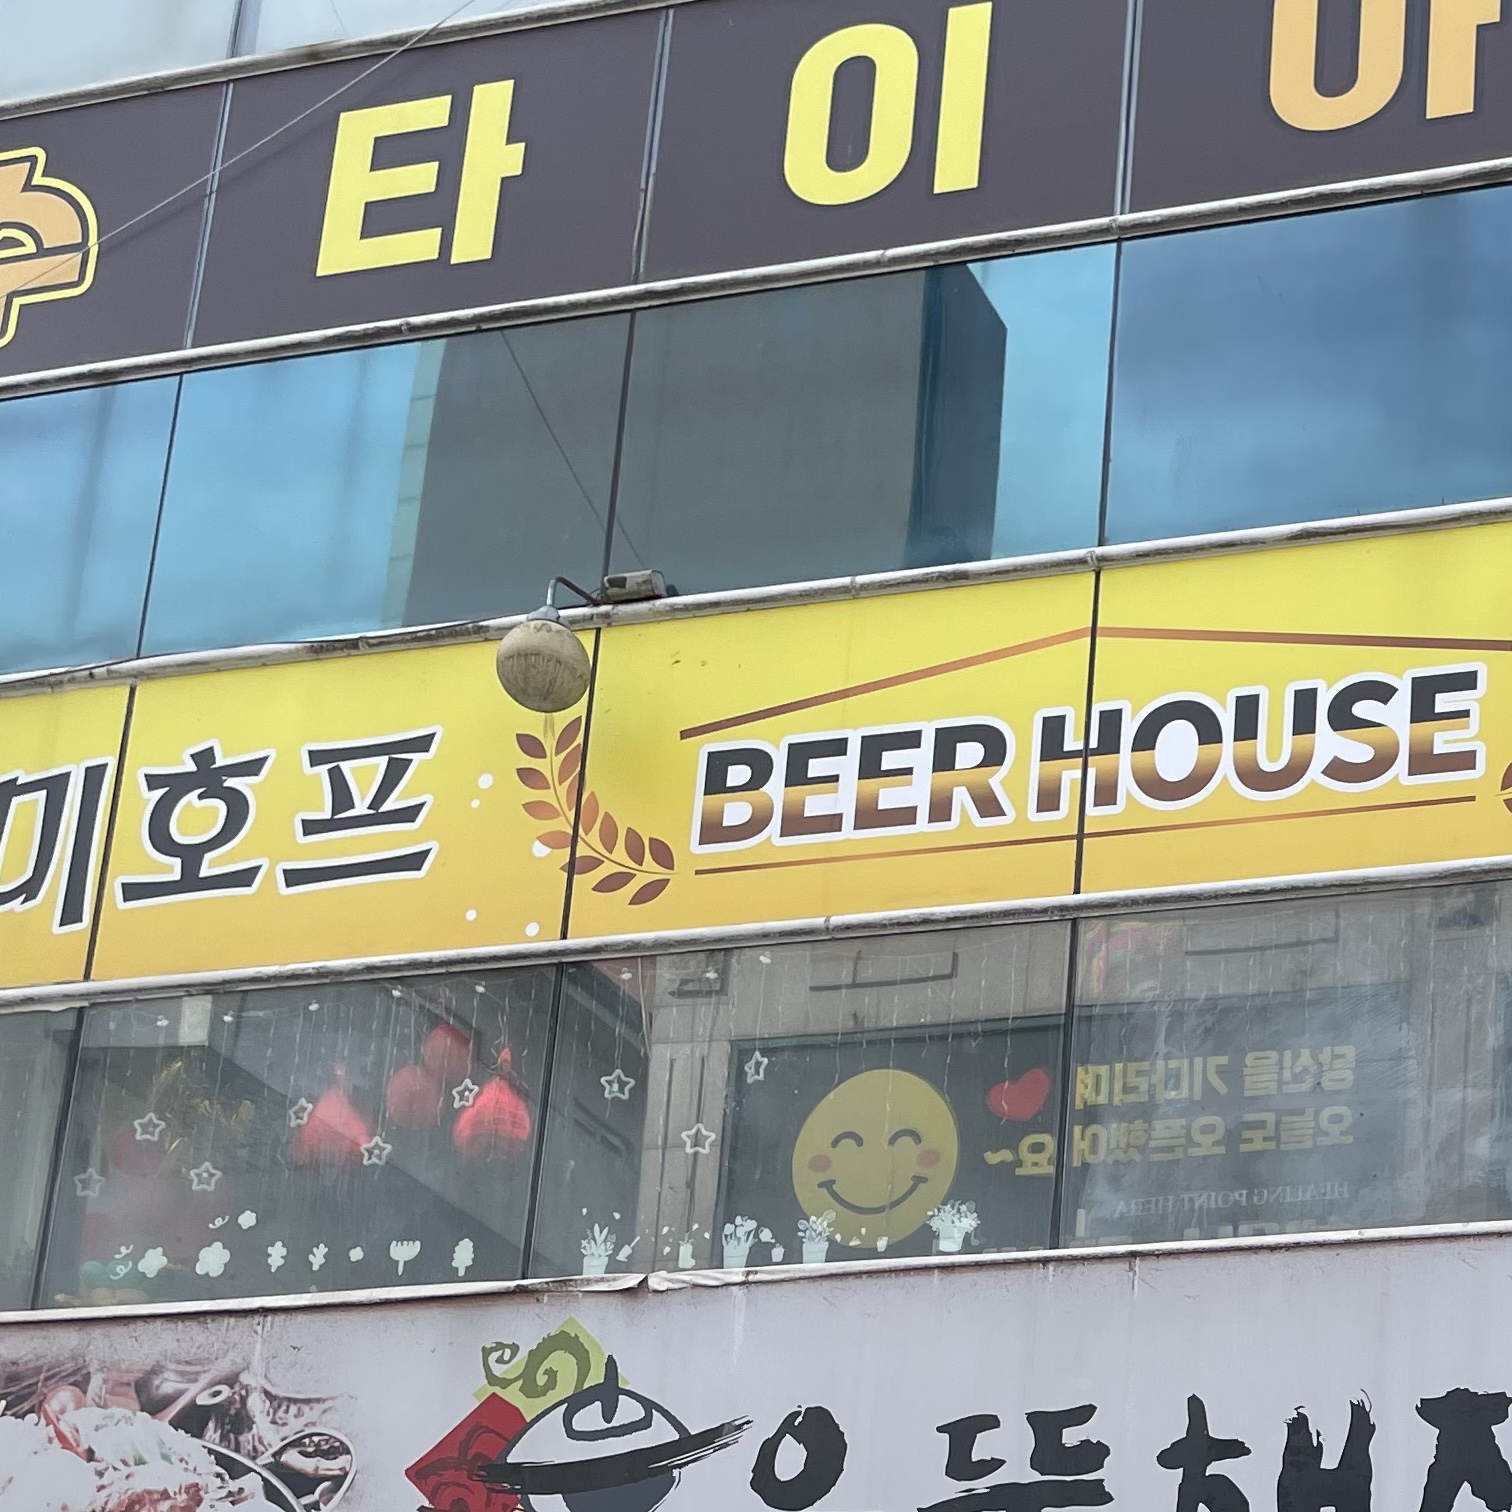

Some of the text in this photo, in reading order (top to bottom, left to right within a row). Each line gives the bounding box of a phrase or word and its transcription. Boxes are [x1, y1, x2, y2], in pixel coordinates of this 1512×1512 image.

[0, 728, 440, 930] 미호프
[695, 667, 1480, 850] BEER HOUSE
